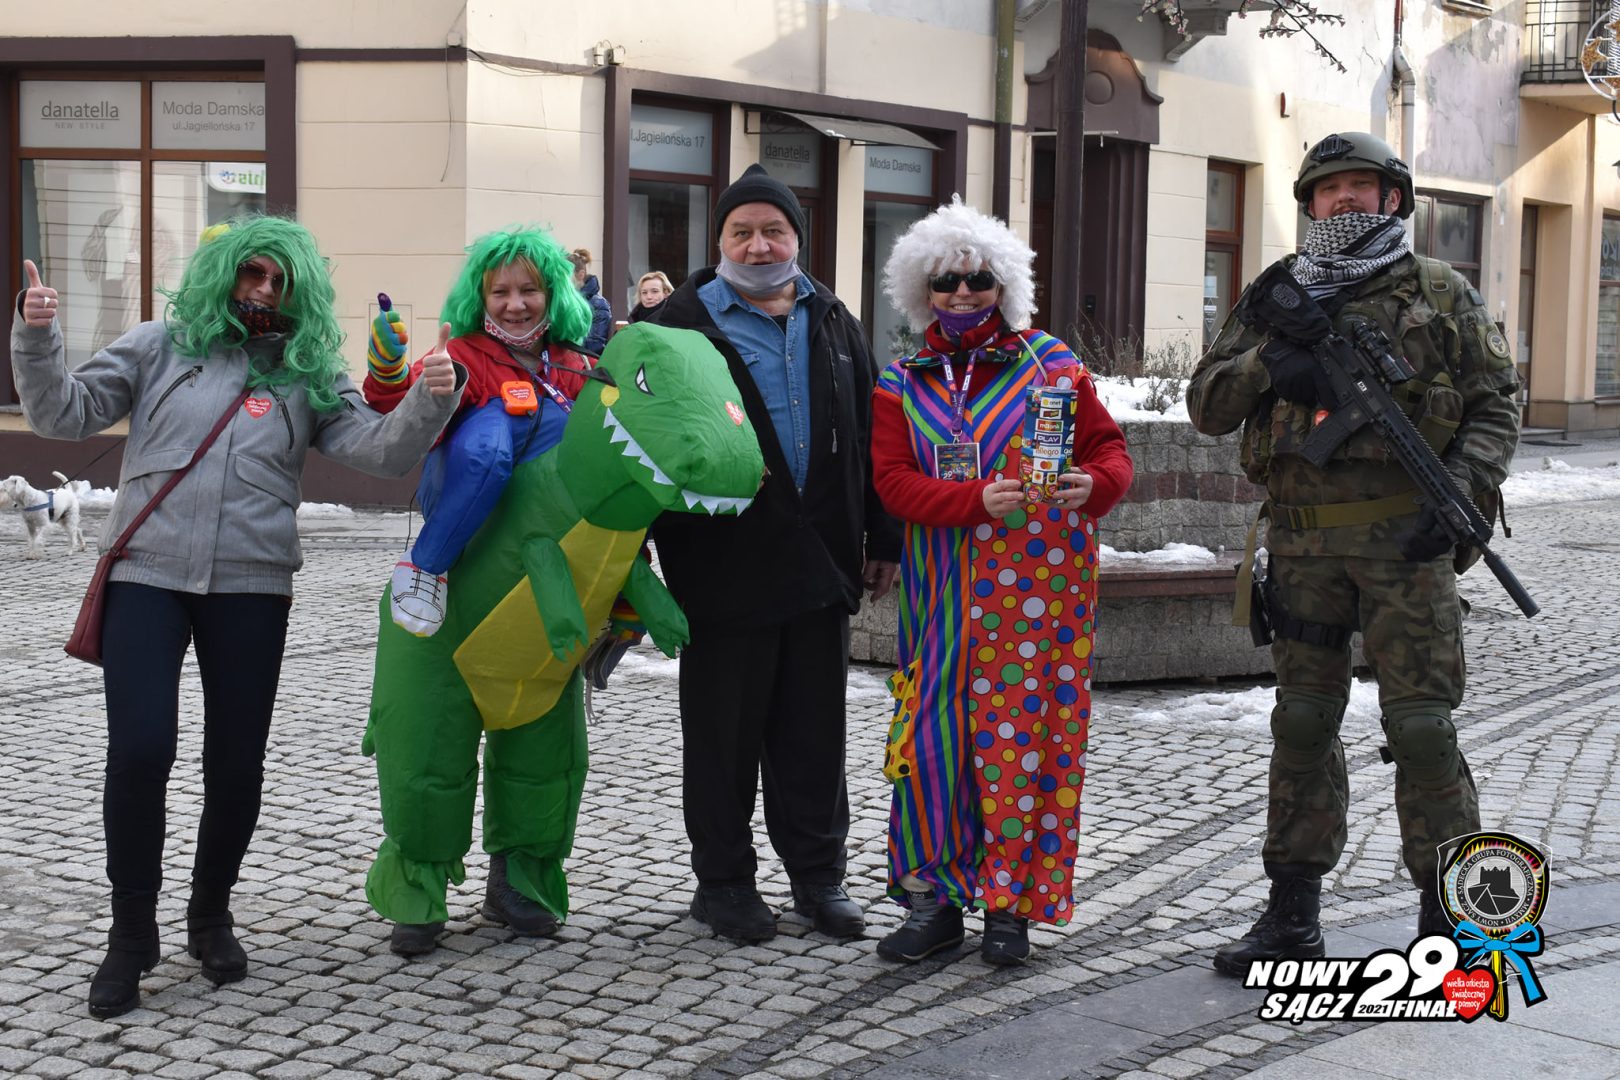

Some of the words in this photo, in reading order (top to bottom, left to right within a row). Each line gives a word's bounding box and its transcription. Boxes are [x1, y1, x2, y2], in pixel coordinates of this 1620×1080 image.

[41, 100, 119, 118] danatella
[162, 101, 202, 115] Moda
[207, 101, 265, 116] Damska
[244, 122, 256, 131] 17
[694, 136, 705, 147] 17
[765, 142, 810, 161] danatella
[869, 156, 891, 170] Moda
[892, 159, 921, 173] Damska
